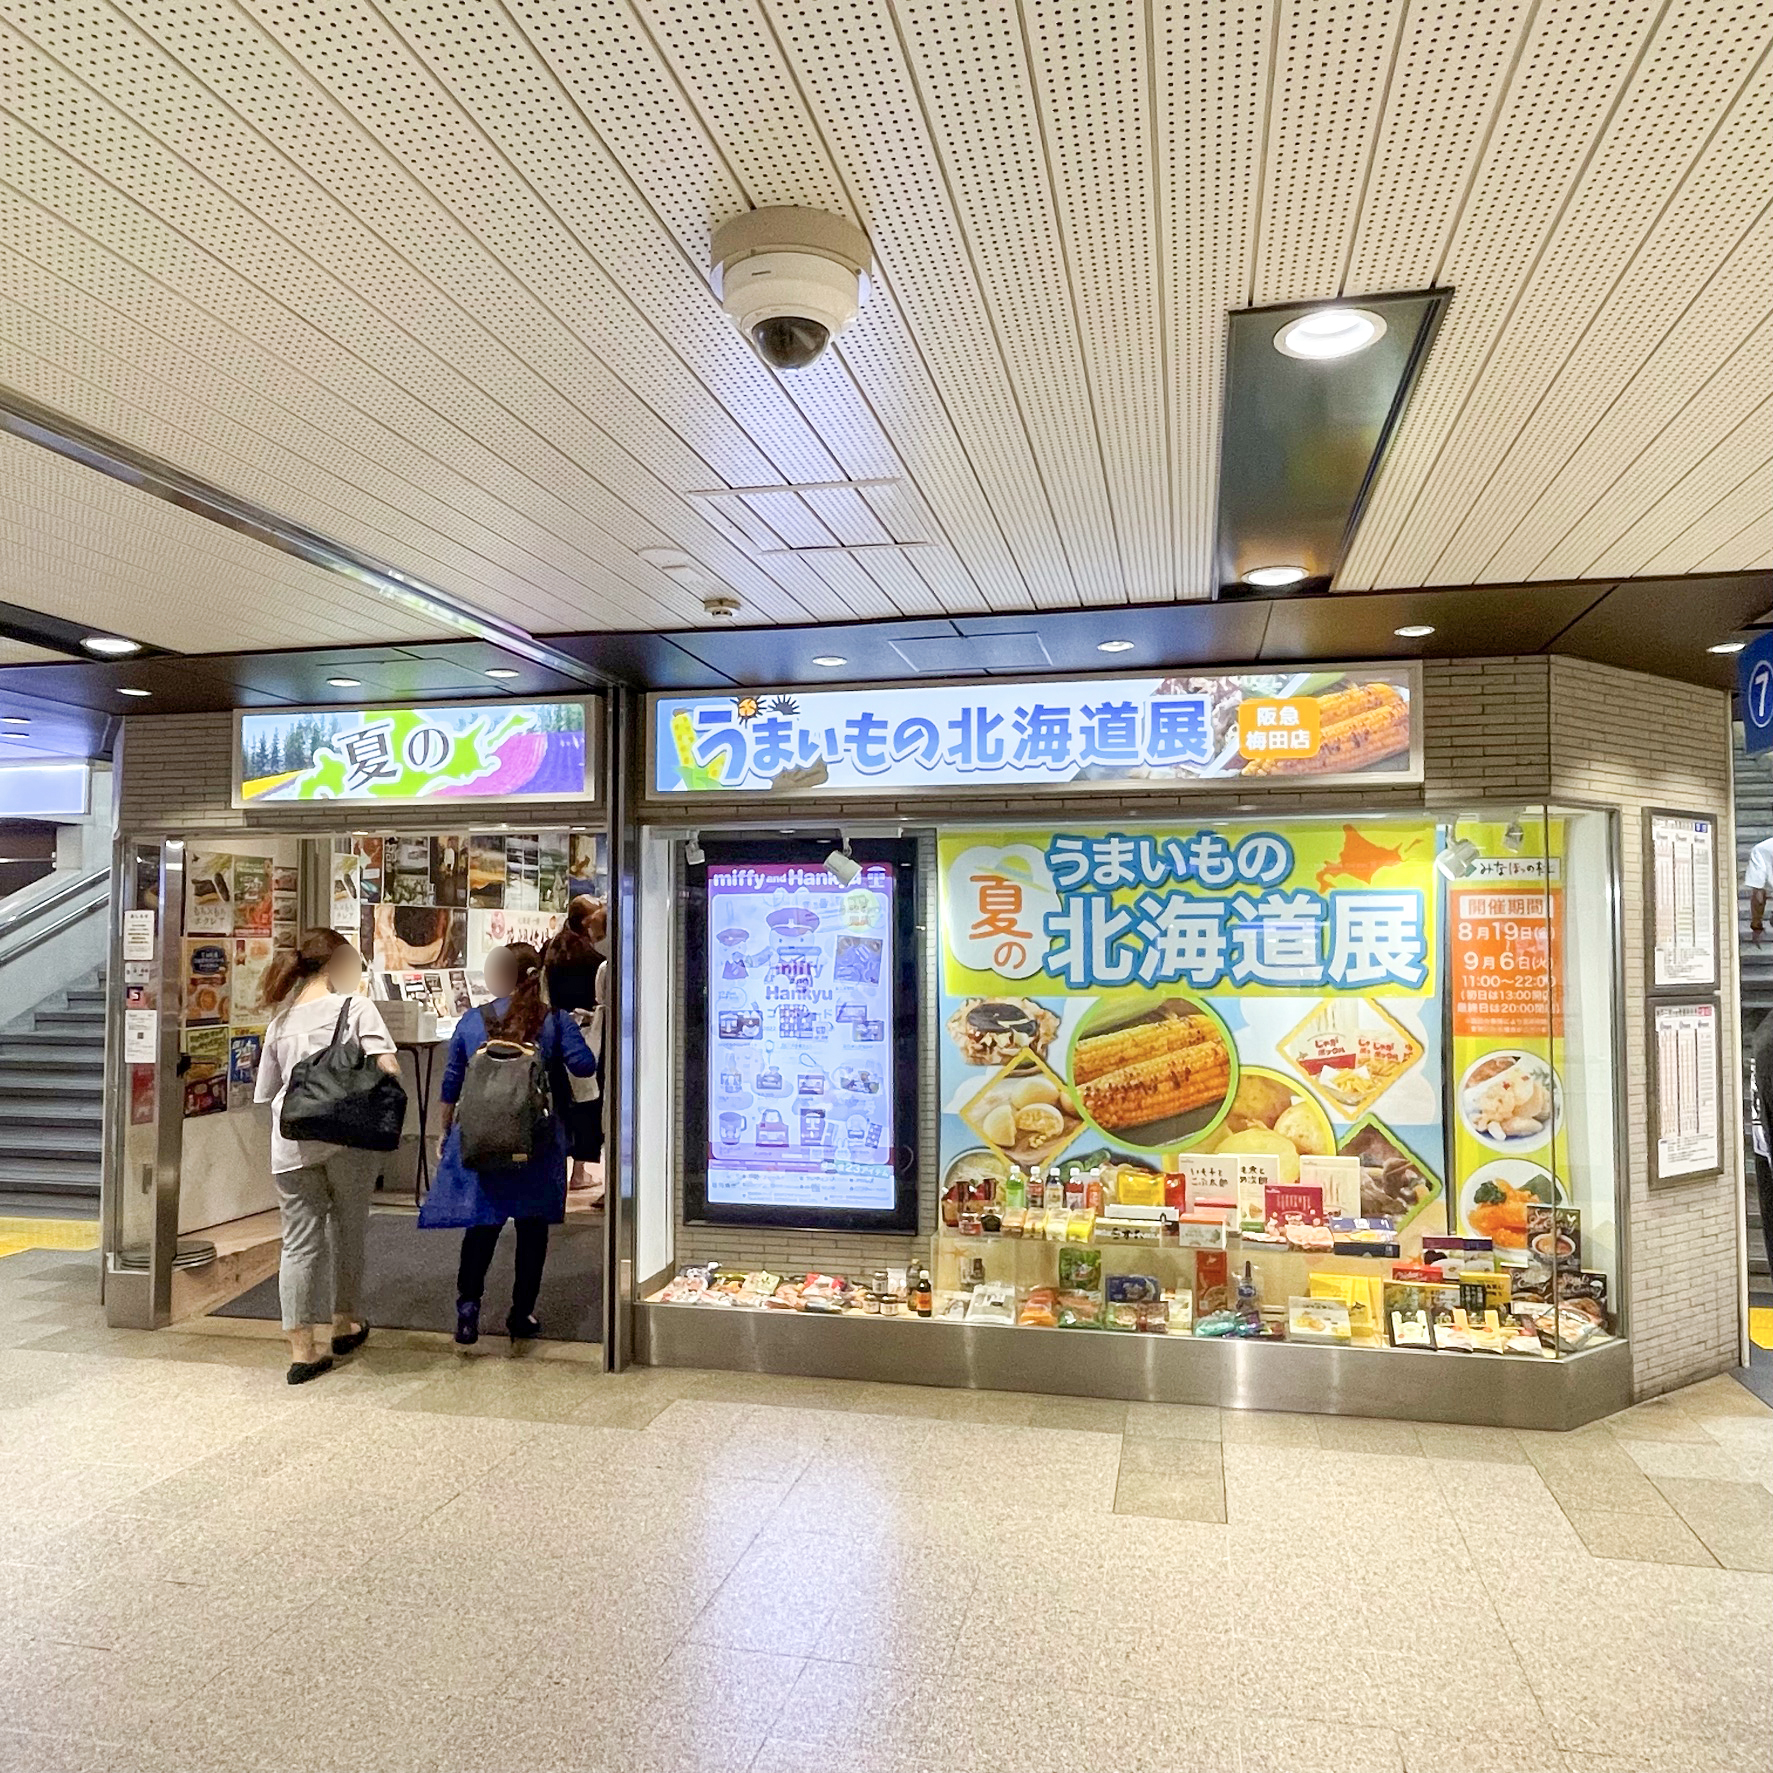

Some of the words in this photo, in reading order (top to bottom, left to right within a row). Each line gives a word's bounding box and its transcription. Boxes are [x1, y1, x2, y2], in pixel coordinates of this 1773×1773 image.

[1257, 706, 1299, 727] 阪急
[1754, 670, 1769, 717] 7
[337, 723, 449, 791] 夏の
[697, 700, 1209, 780] うまいもの北海道展
[1246, 730, 1310, 751] 梅田店
[713, 869, 765, 890] miffy
[766, 874, 787, 883] and
[1050, 836, 1287, 884] うまいもの
[968, 874, 1033, 969] 夏の
[1468, 898, 1544, 915] 開催期間
[1047, 893, 1422, 983] 北海道展
[765, 986, 833, 1004] Hankyu
